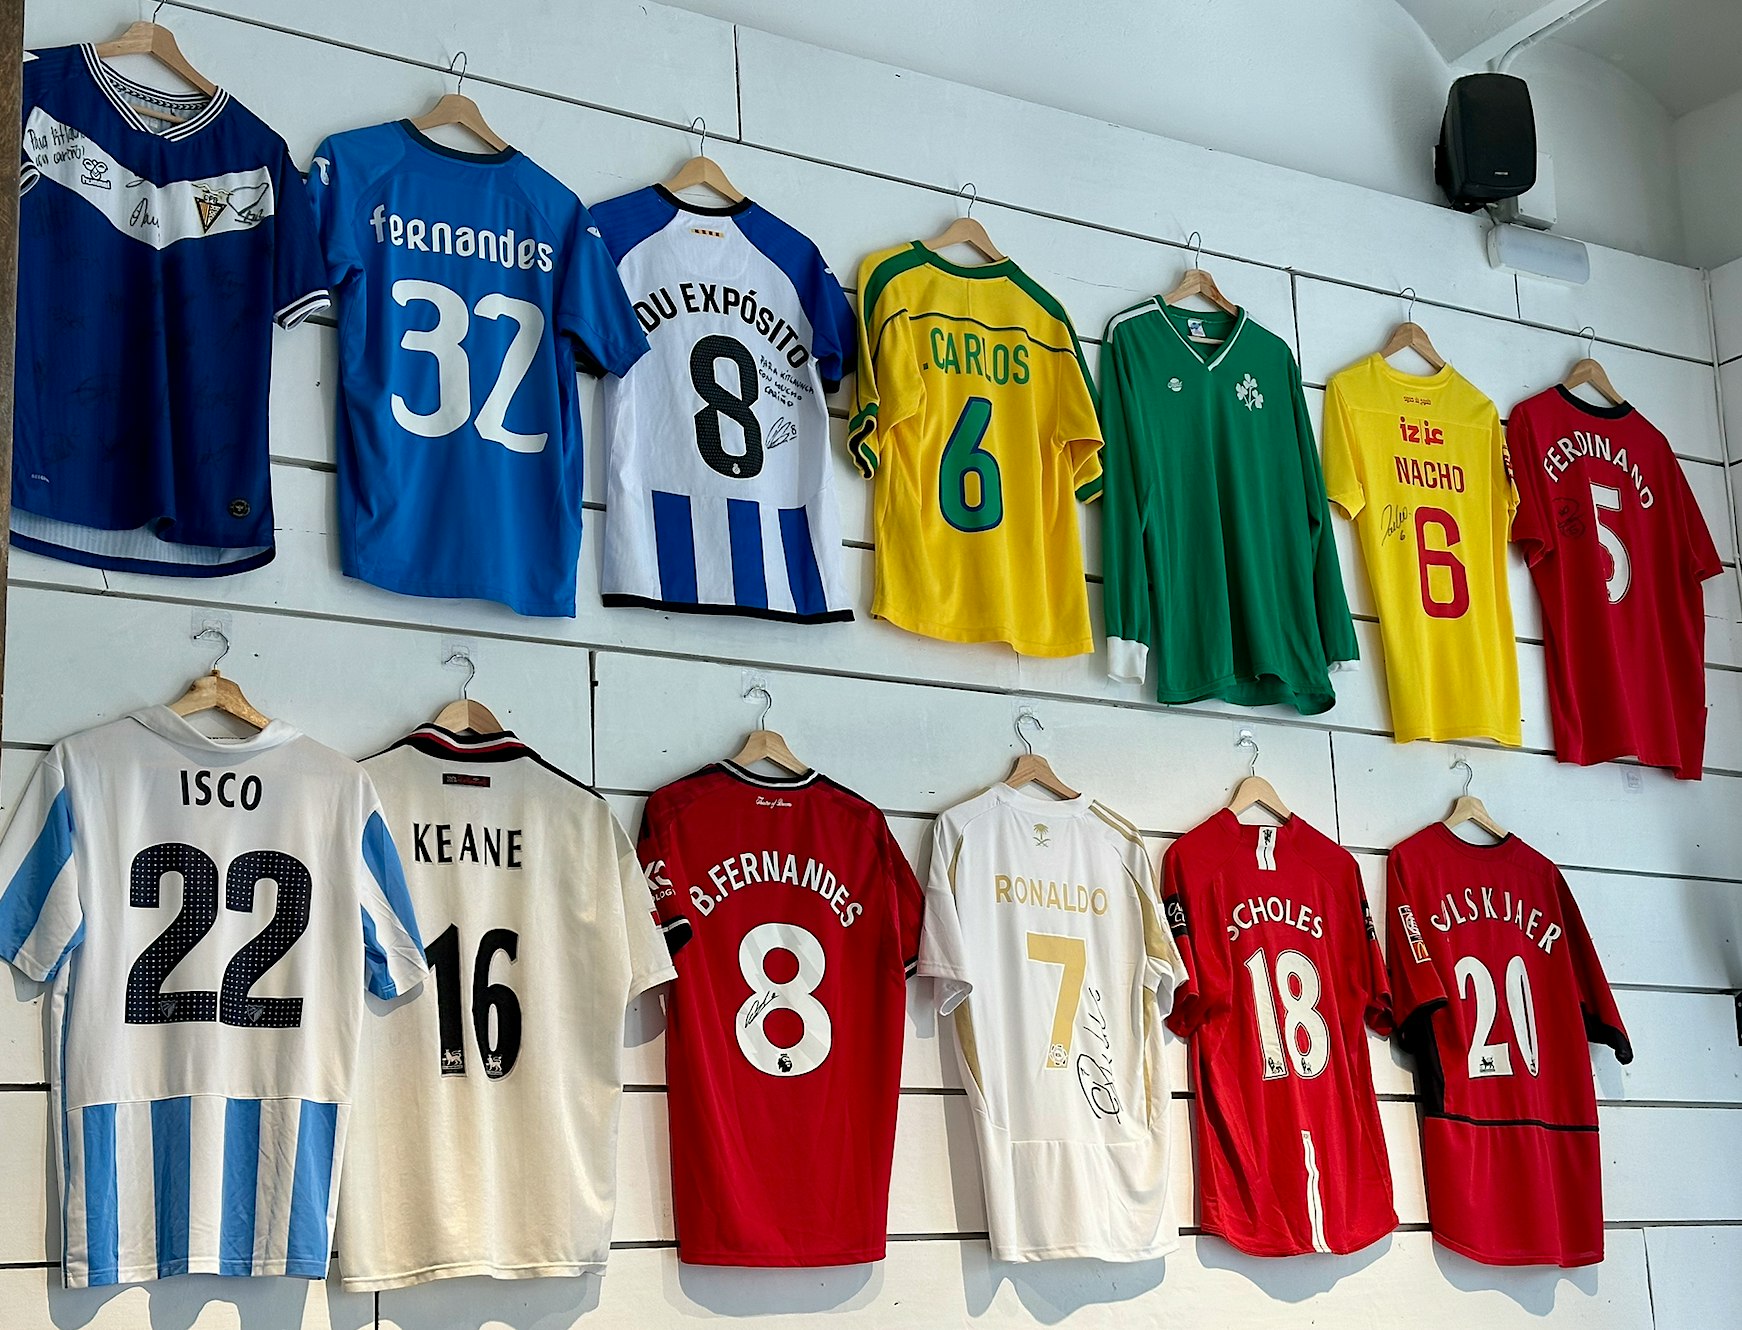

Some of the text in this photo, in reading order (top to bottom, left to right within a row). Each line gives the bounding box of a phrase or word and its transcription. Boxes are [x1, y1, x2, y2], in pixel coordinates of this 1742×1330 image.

[369, 204, 554, 273] fernandes
[390, 279, 549, 453] 32
[634, 282, 810, 369] DU EXPÓSITO
[923, 326, 1031, 387] .CARLOS
[689, 333, 765, 480] 8
[938, 396, 1004, 533] 6
[1394, 455, 1465, 494] NACHO
[1542, 429, 1655, 510] FERDINAND
[1413, 505, 1471, 620] 6
[1589, 481, 1632, 605] 5
[179, 769, 263, 812] ISCO
[412, 821, 524, 871] KEANE
[124, 842, 313, 1029] 22
[689, 850, 864, 929] B.FERNANDES
[994, 873, 1109, 917] RONALDO
[423, 922, 523, 1083] 16
[735, 921, 832, 1078] 8
[1026, 930, 1087, 1070] 7
[1243, 946, 1331, 1081] 18
[1453, 955, 1540, 1080] 20
